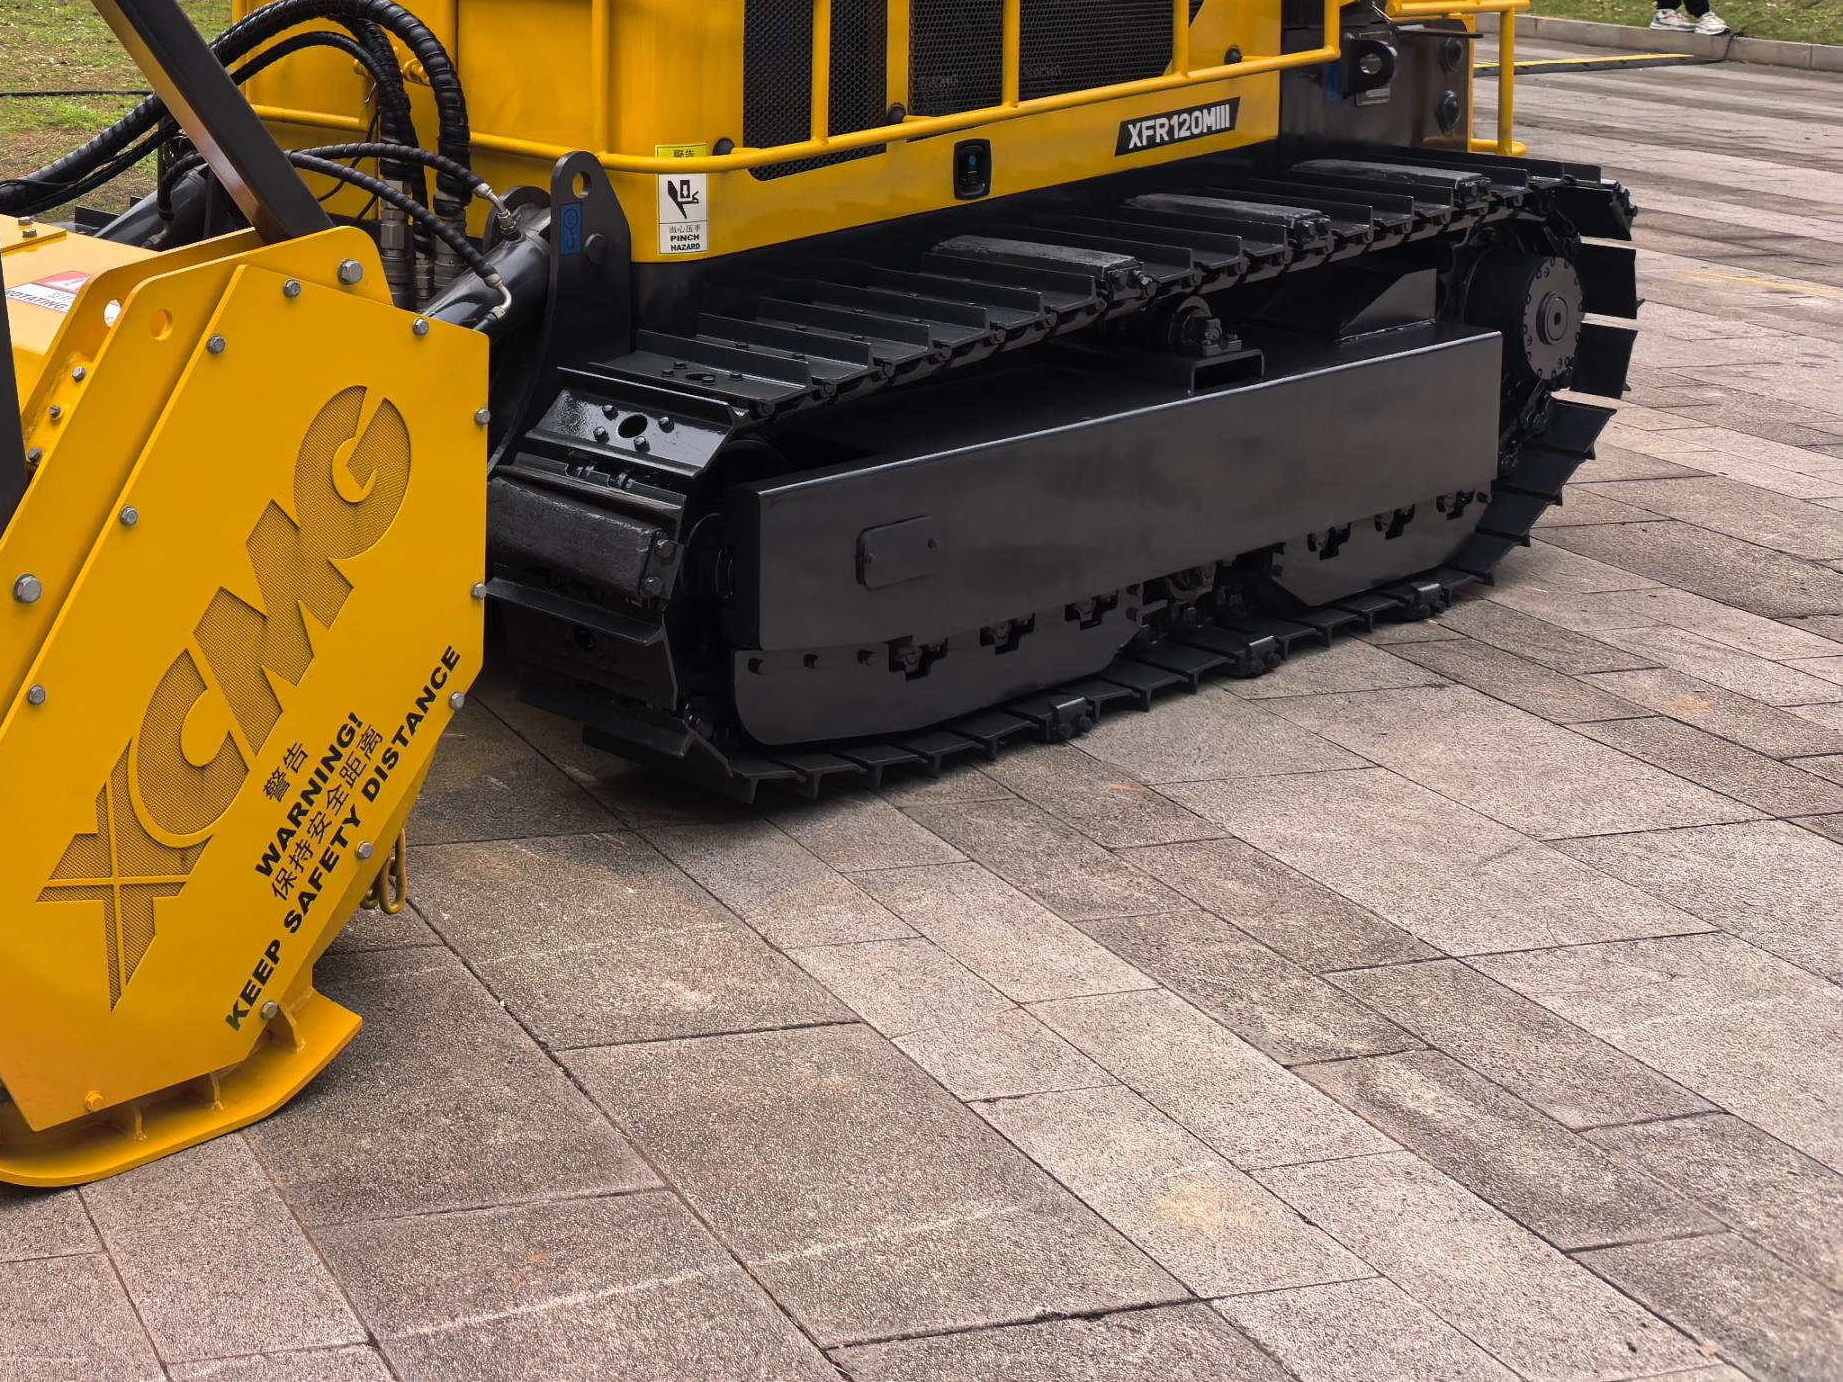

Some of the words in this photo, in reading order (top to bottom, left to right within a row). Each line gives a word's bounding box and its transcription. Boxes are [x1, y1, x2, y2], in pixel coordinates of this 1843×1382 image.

[670, 233, 700, 242] PINCH
[670, 242, 701, 251] HAZARD
[36, 385, 411, 1013] XCMG
[263, 741, 309, 803] 警告
[225, 938, 281, 1032] KEEP
[284, 803, 361, 934] SAFETY
[361, 645, 461, 803] DISTANCE
[255, 712, 364, 878] WARNING!
[271, 724, 383, 901] 保持安全距离
